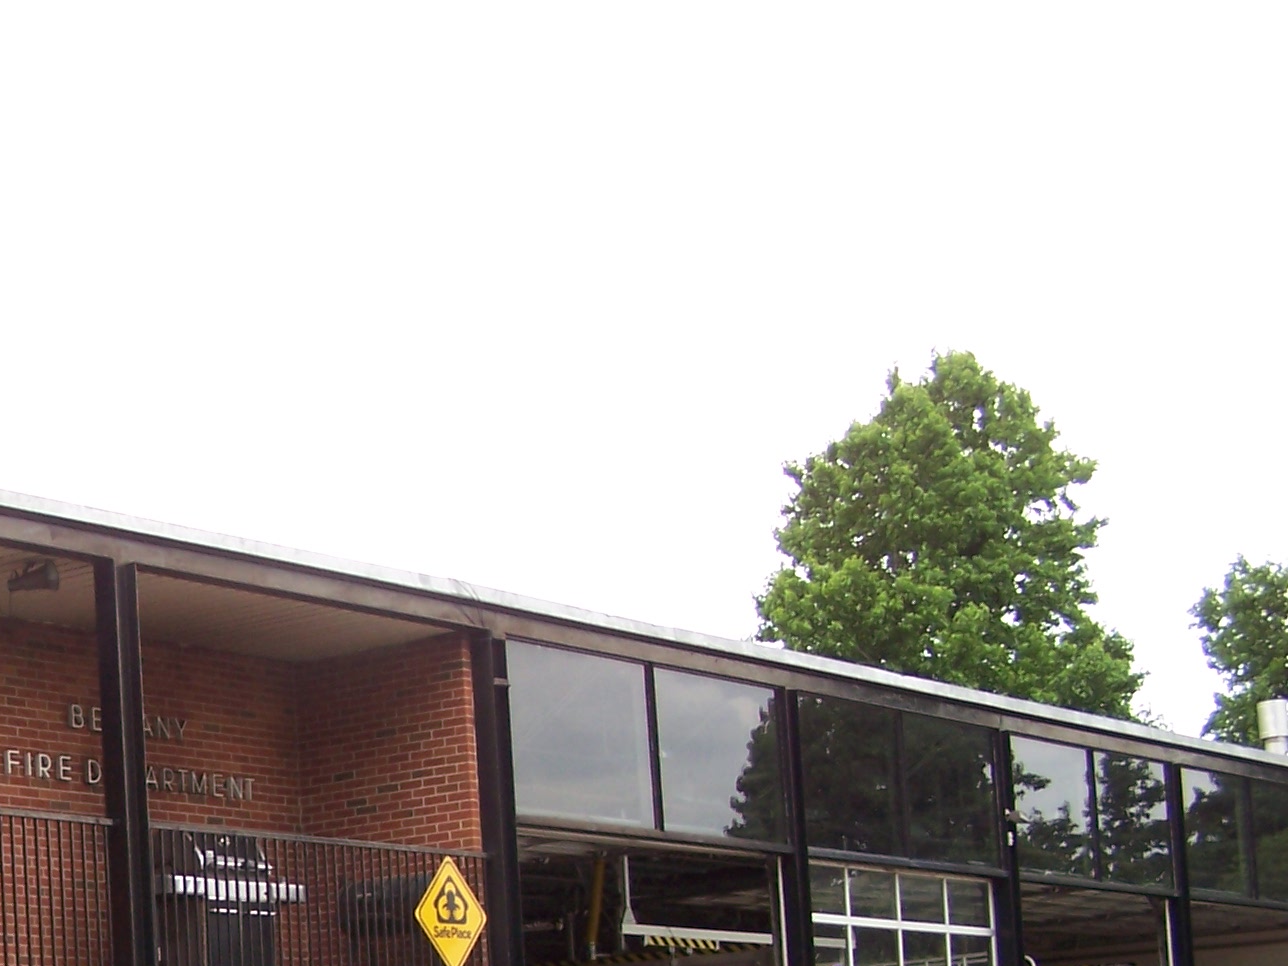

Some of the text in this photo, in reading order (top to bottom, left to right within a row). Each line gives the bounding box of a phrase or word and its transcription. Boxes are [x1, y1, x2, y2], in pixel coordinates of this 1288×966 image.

[68, 703, 187, 739] BEANY
[4, 749, 255, 800] FIRE DARTMENT
